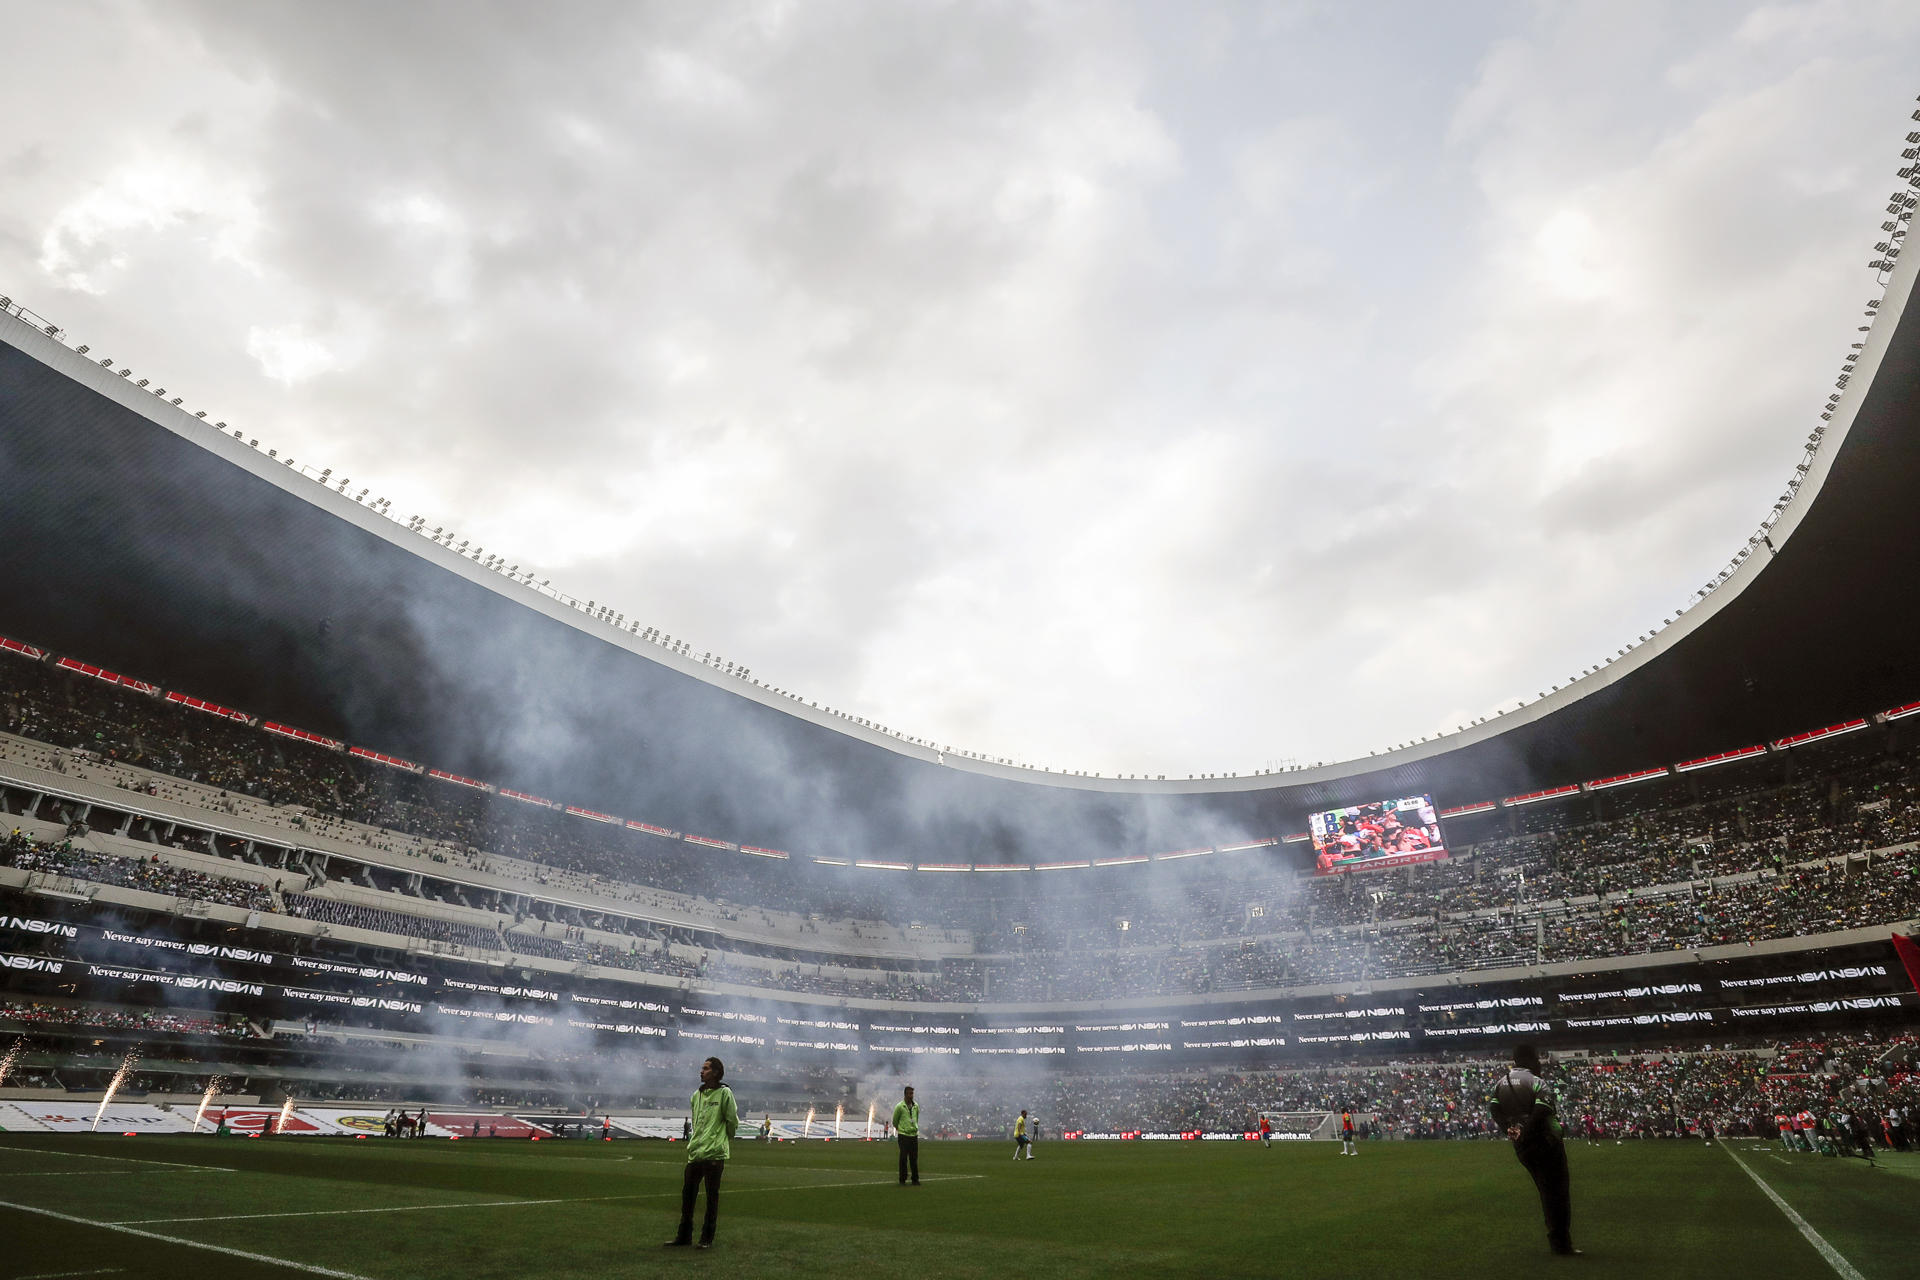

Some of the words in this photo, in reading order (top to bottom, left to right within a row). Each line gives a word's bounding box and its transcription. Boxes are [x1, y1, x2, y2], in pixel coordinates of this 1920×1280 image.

[1351, 854, 1434, 870] BANORTE
[102, 930, 135, 942] Never
[136, 938, 154, 947] say
[154, 940, 185, 950] never.
[291, 957, 318, 968] Never
[318, 963, 332, 972] say
[333, 966, 358, 974] never.
[88, 966, 121, 978] Never
[122, 972, 142, 982] say
[142, 974, 173, 984] never.
[443, 978, 465, 988] Never
[1720, 980, 1748, 988] Never
[282, 988, 310, 998] Never
[310, 993, 325, 1002] say
[325, 995, 350, 1003] never.
[571, 994, 589, 1002] Never
[437, 1006, 460, 1015] Never
[1731, 1008, 1759, 1016] Never
[568, 1019, 586, 1028] Never
